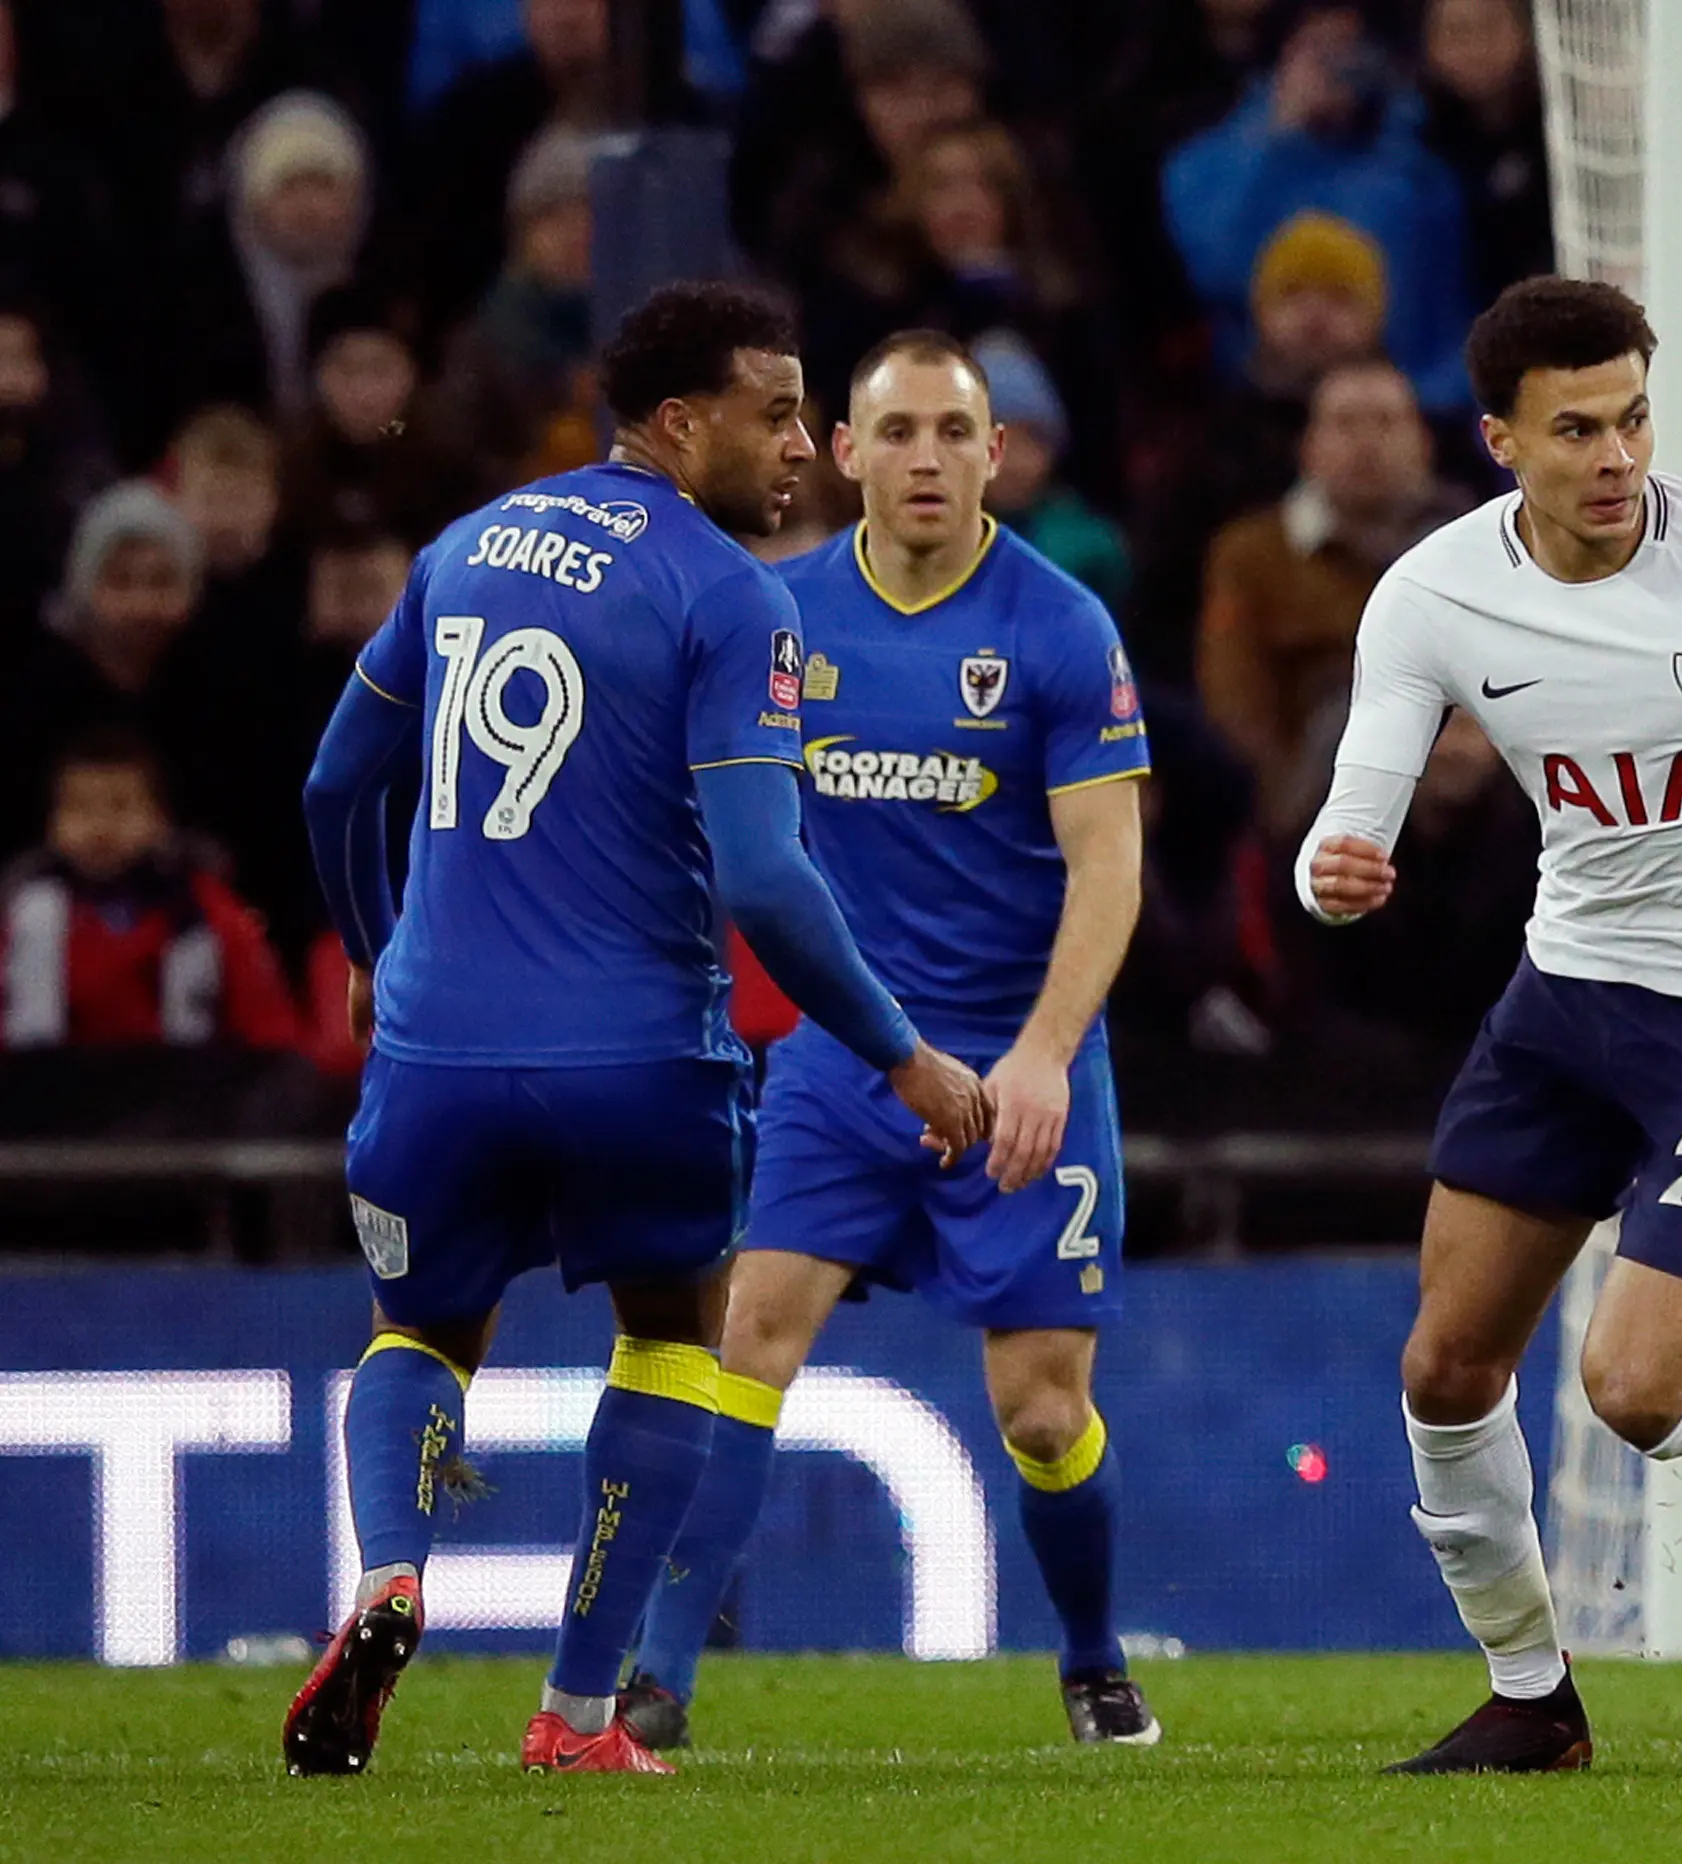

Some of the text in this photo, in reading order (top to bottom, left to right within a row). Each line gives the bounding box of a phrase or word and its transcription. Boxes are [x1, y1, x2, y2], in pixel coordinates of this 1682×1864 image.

[467, 524, 613, 593] SOARES
[430, 616, 584, 840] 19
[812, 749, 984, 782] FOOTBALL
[814, 772, 984, 803] MANAGER
[1055, 1165, 1100, 1260] 2
[572, 1477, 630, 1618] WIMBLEDON
